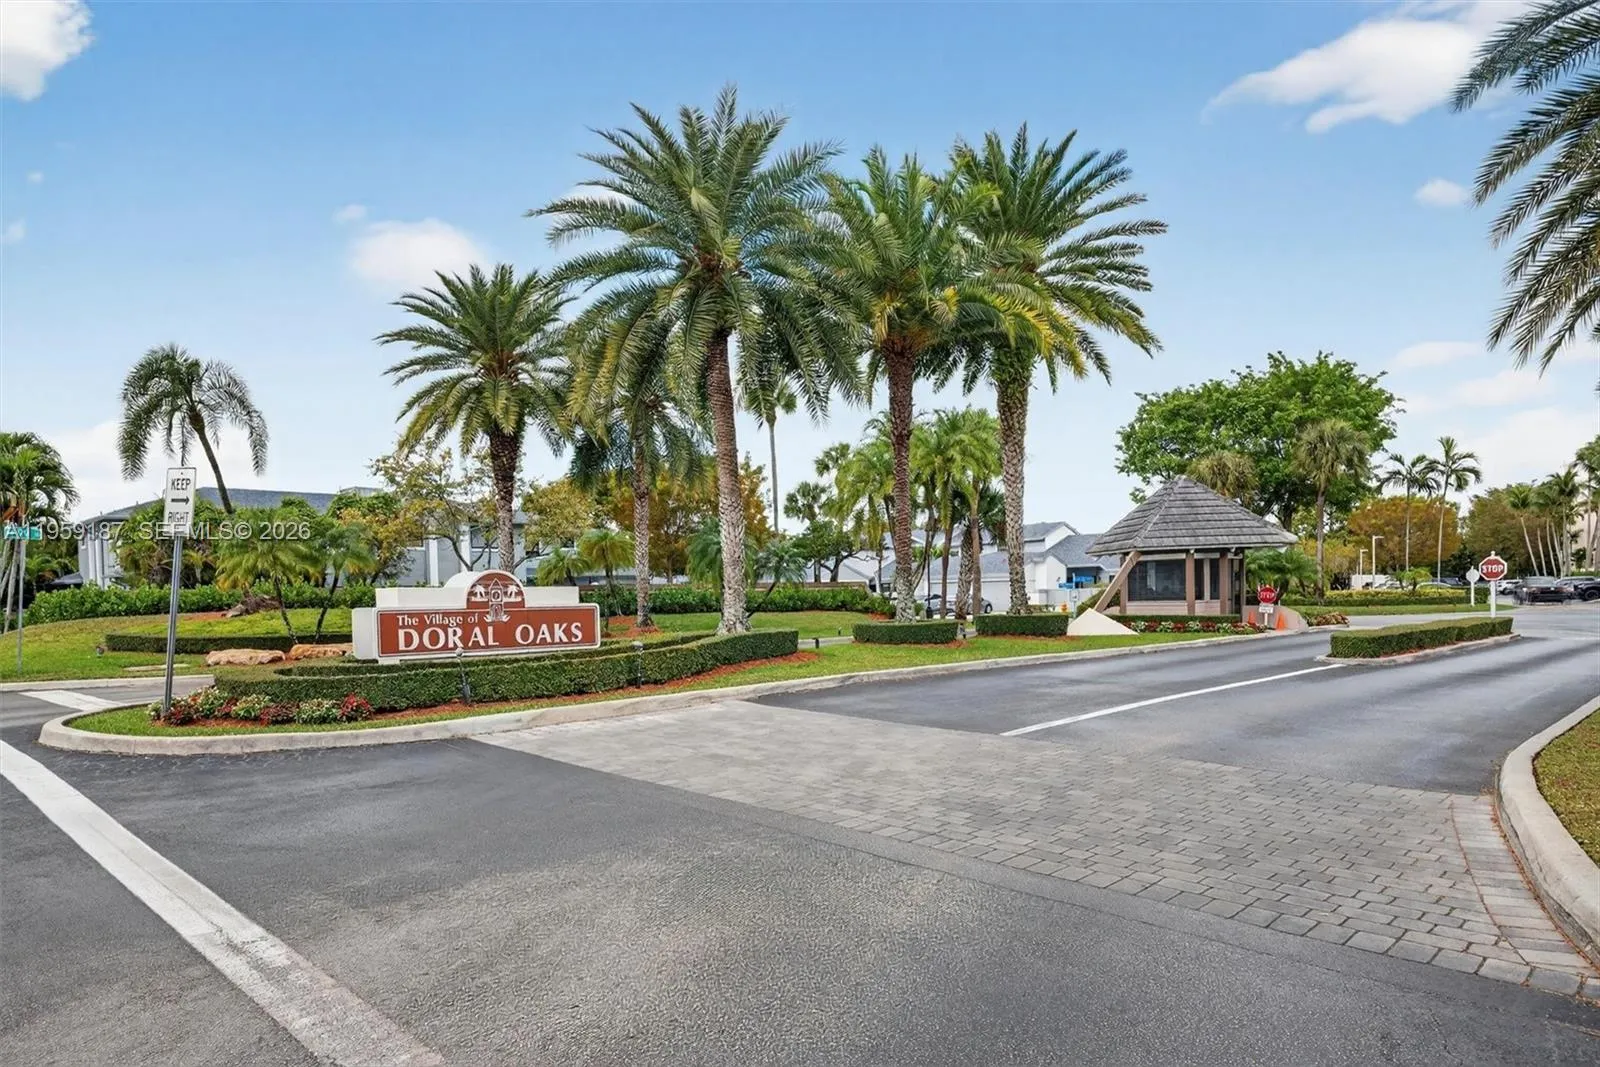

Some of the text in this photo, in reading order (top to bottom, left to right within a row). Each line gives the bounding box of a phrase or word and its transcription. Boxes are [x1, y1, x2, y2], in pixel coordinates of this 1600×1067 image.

[171, 478, 191, 490] KEEP
[168, 511, 189, 524] RIGHT
[1481, 564, 1504, 573] STOP
[1260, 591, 1275, 599] STOP
[397, 612, 479, 627] The Village of
[398, 622, 583, 651] DORAL OAKS
